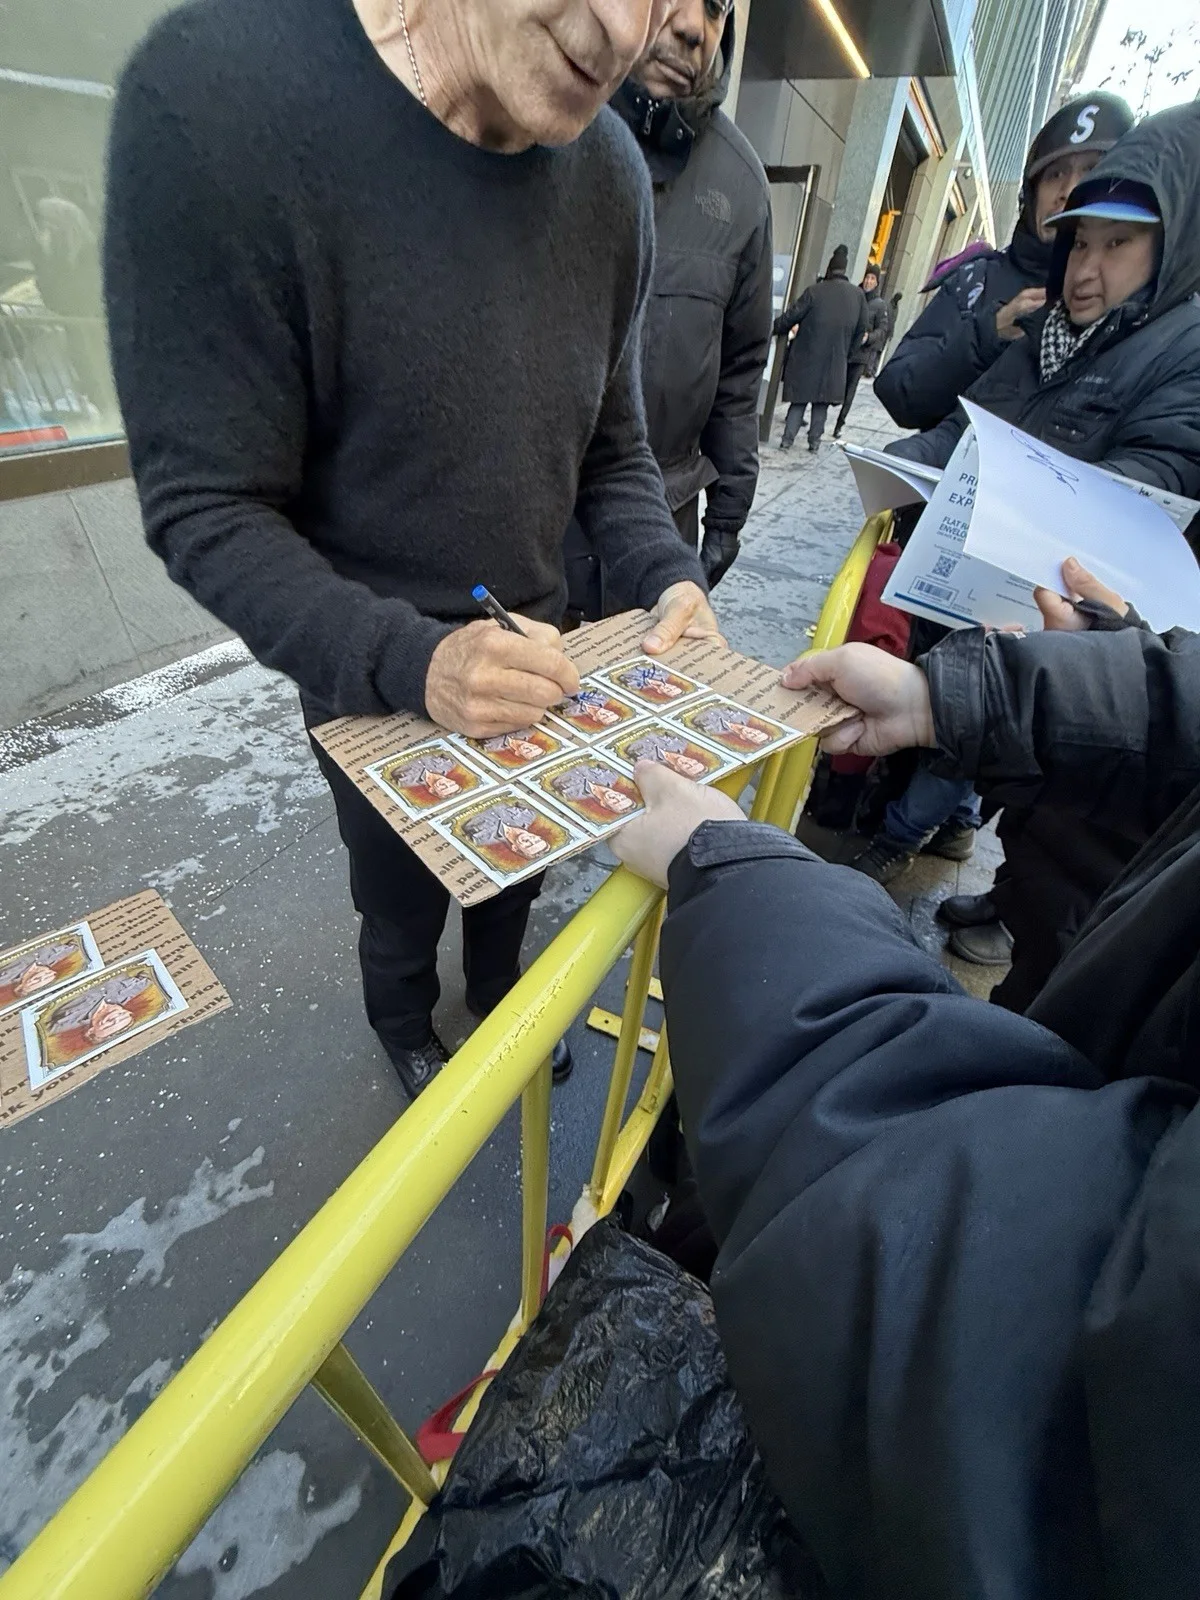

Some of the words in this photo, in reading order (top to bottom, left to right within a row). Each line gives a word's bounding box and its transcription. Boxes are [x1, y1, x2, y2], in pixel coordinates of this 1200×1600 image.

[1070, 105, 1100, 144] S
[942, 516, 961, 527] FLAT
[115, 904, 165, 927] Thank
[165, 994, 229, 1030] Thank
[30, 1070, 76, 1101] you
